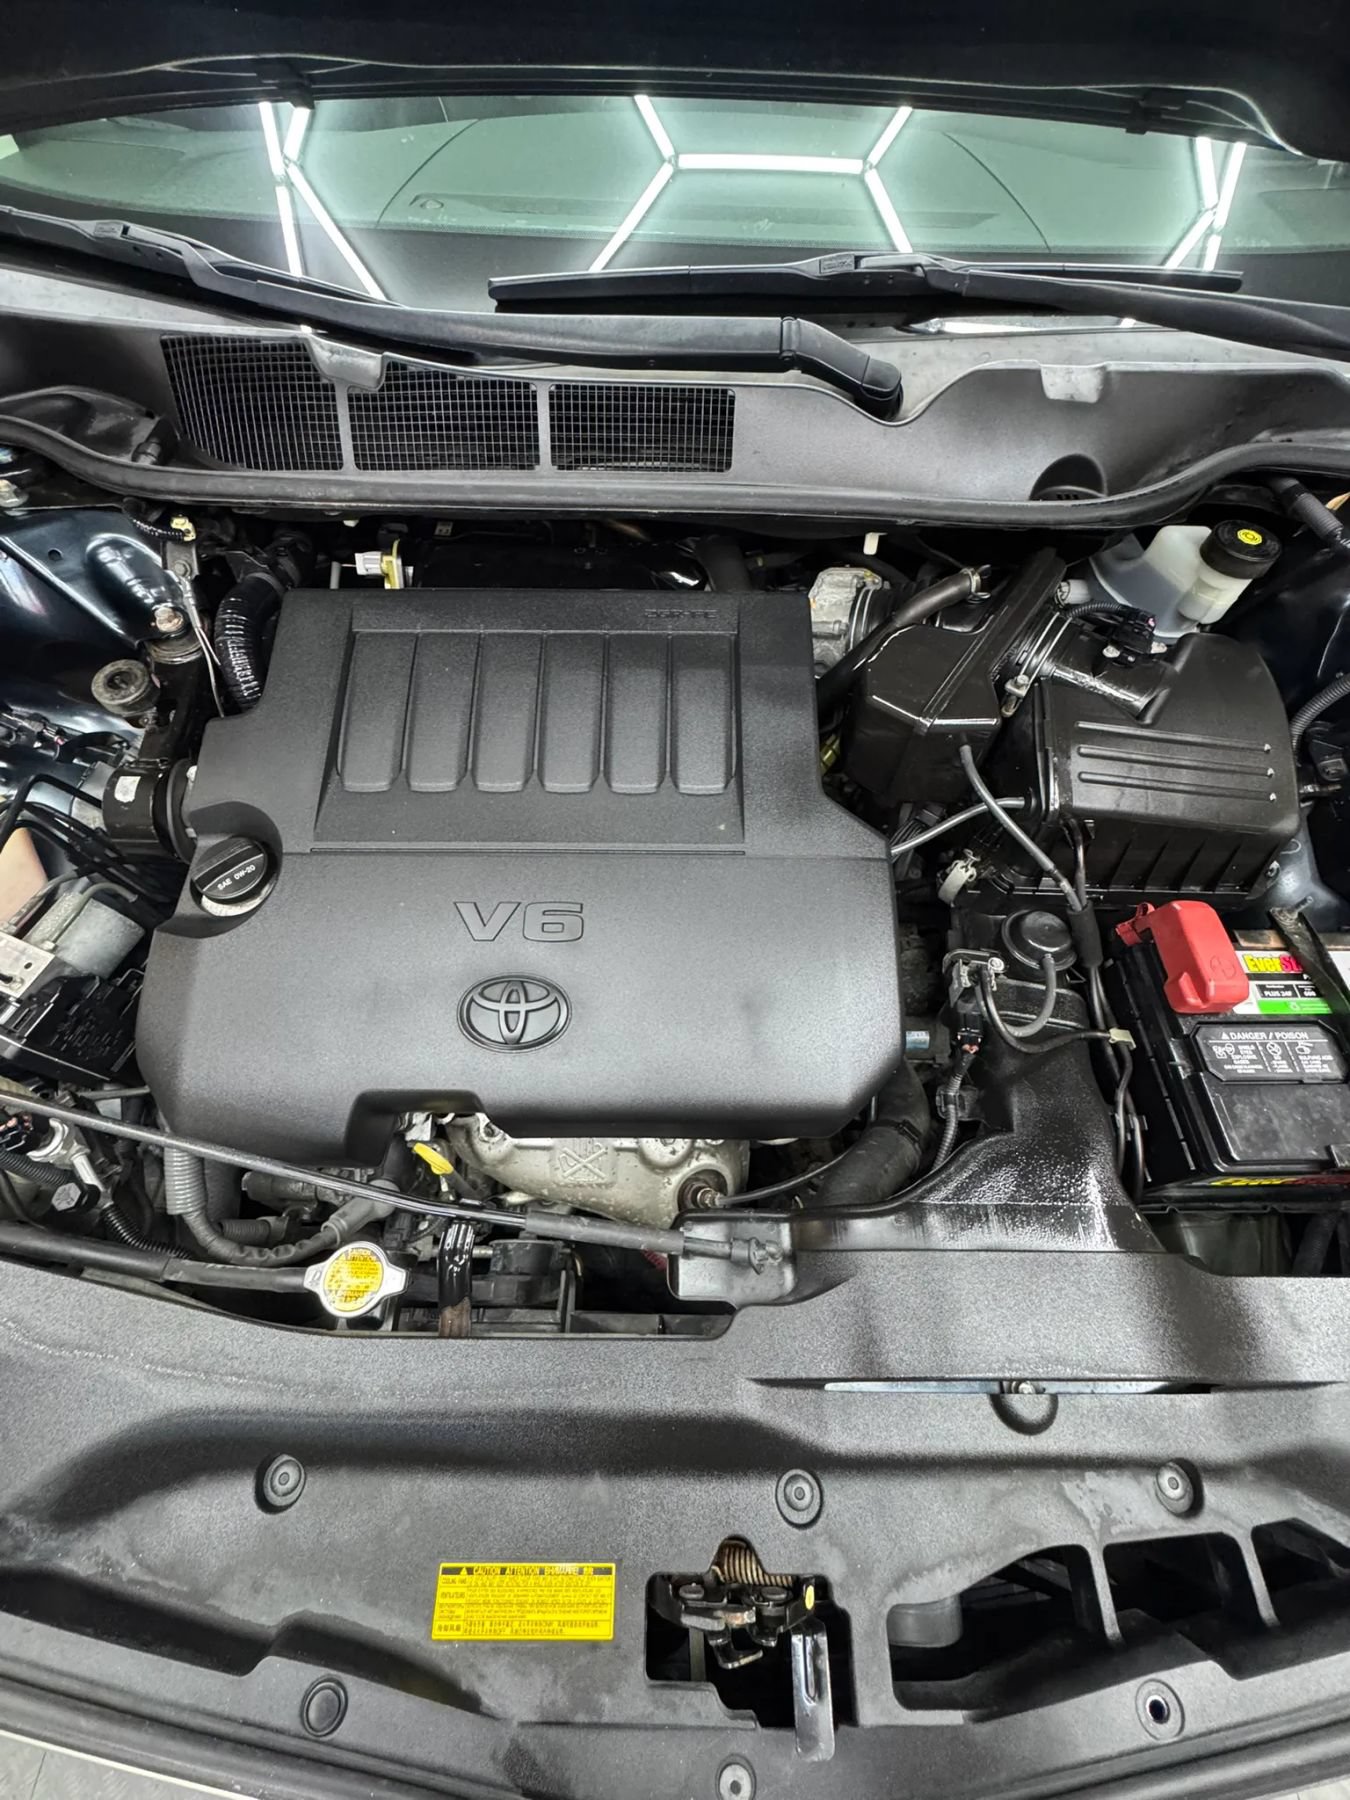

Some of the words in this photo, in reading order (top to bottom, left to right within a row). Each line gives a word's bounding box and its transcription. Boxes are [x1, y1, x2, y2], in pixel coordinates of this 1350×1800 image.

[217, 878, 232, 891] SAE
[233, 864, 256, 880] 0W-20
[453, 901, 585, 943] V6
[1243, 953, 1303, 973] EverSt
[1229, 1031, 1267, 1040] DANGER
[1274, 1031, 1309, 1040] POISON
[472, 1567, 501, 1576] CAUTION
[504, 1567, 540, 1576] ATTENTION
